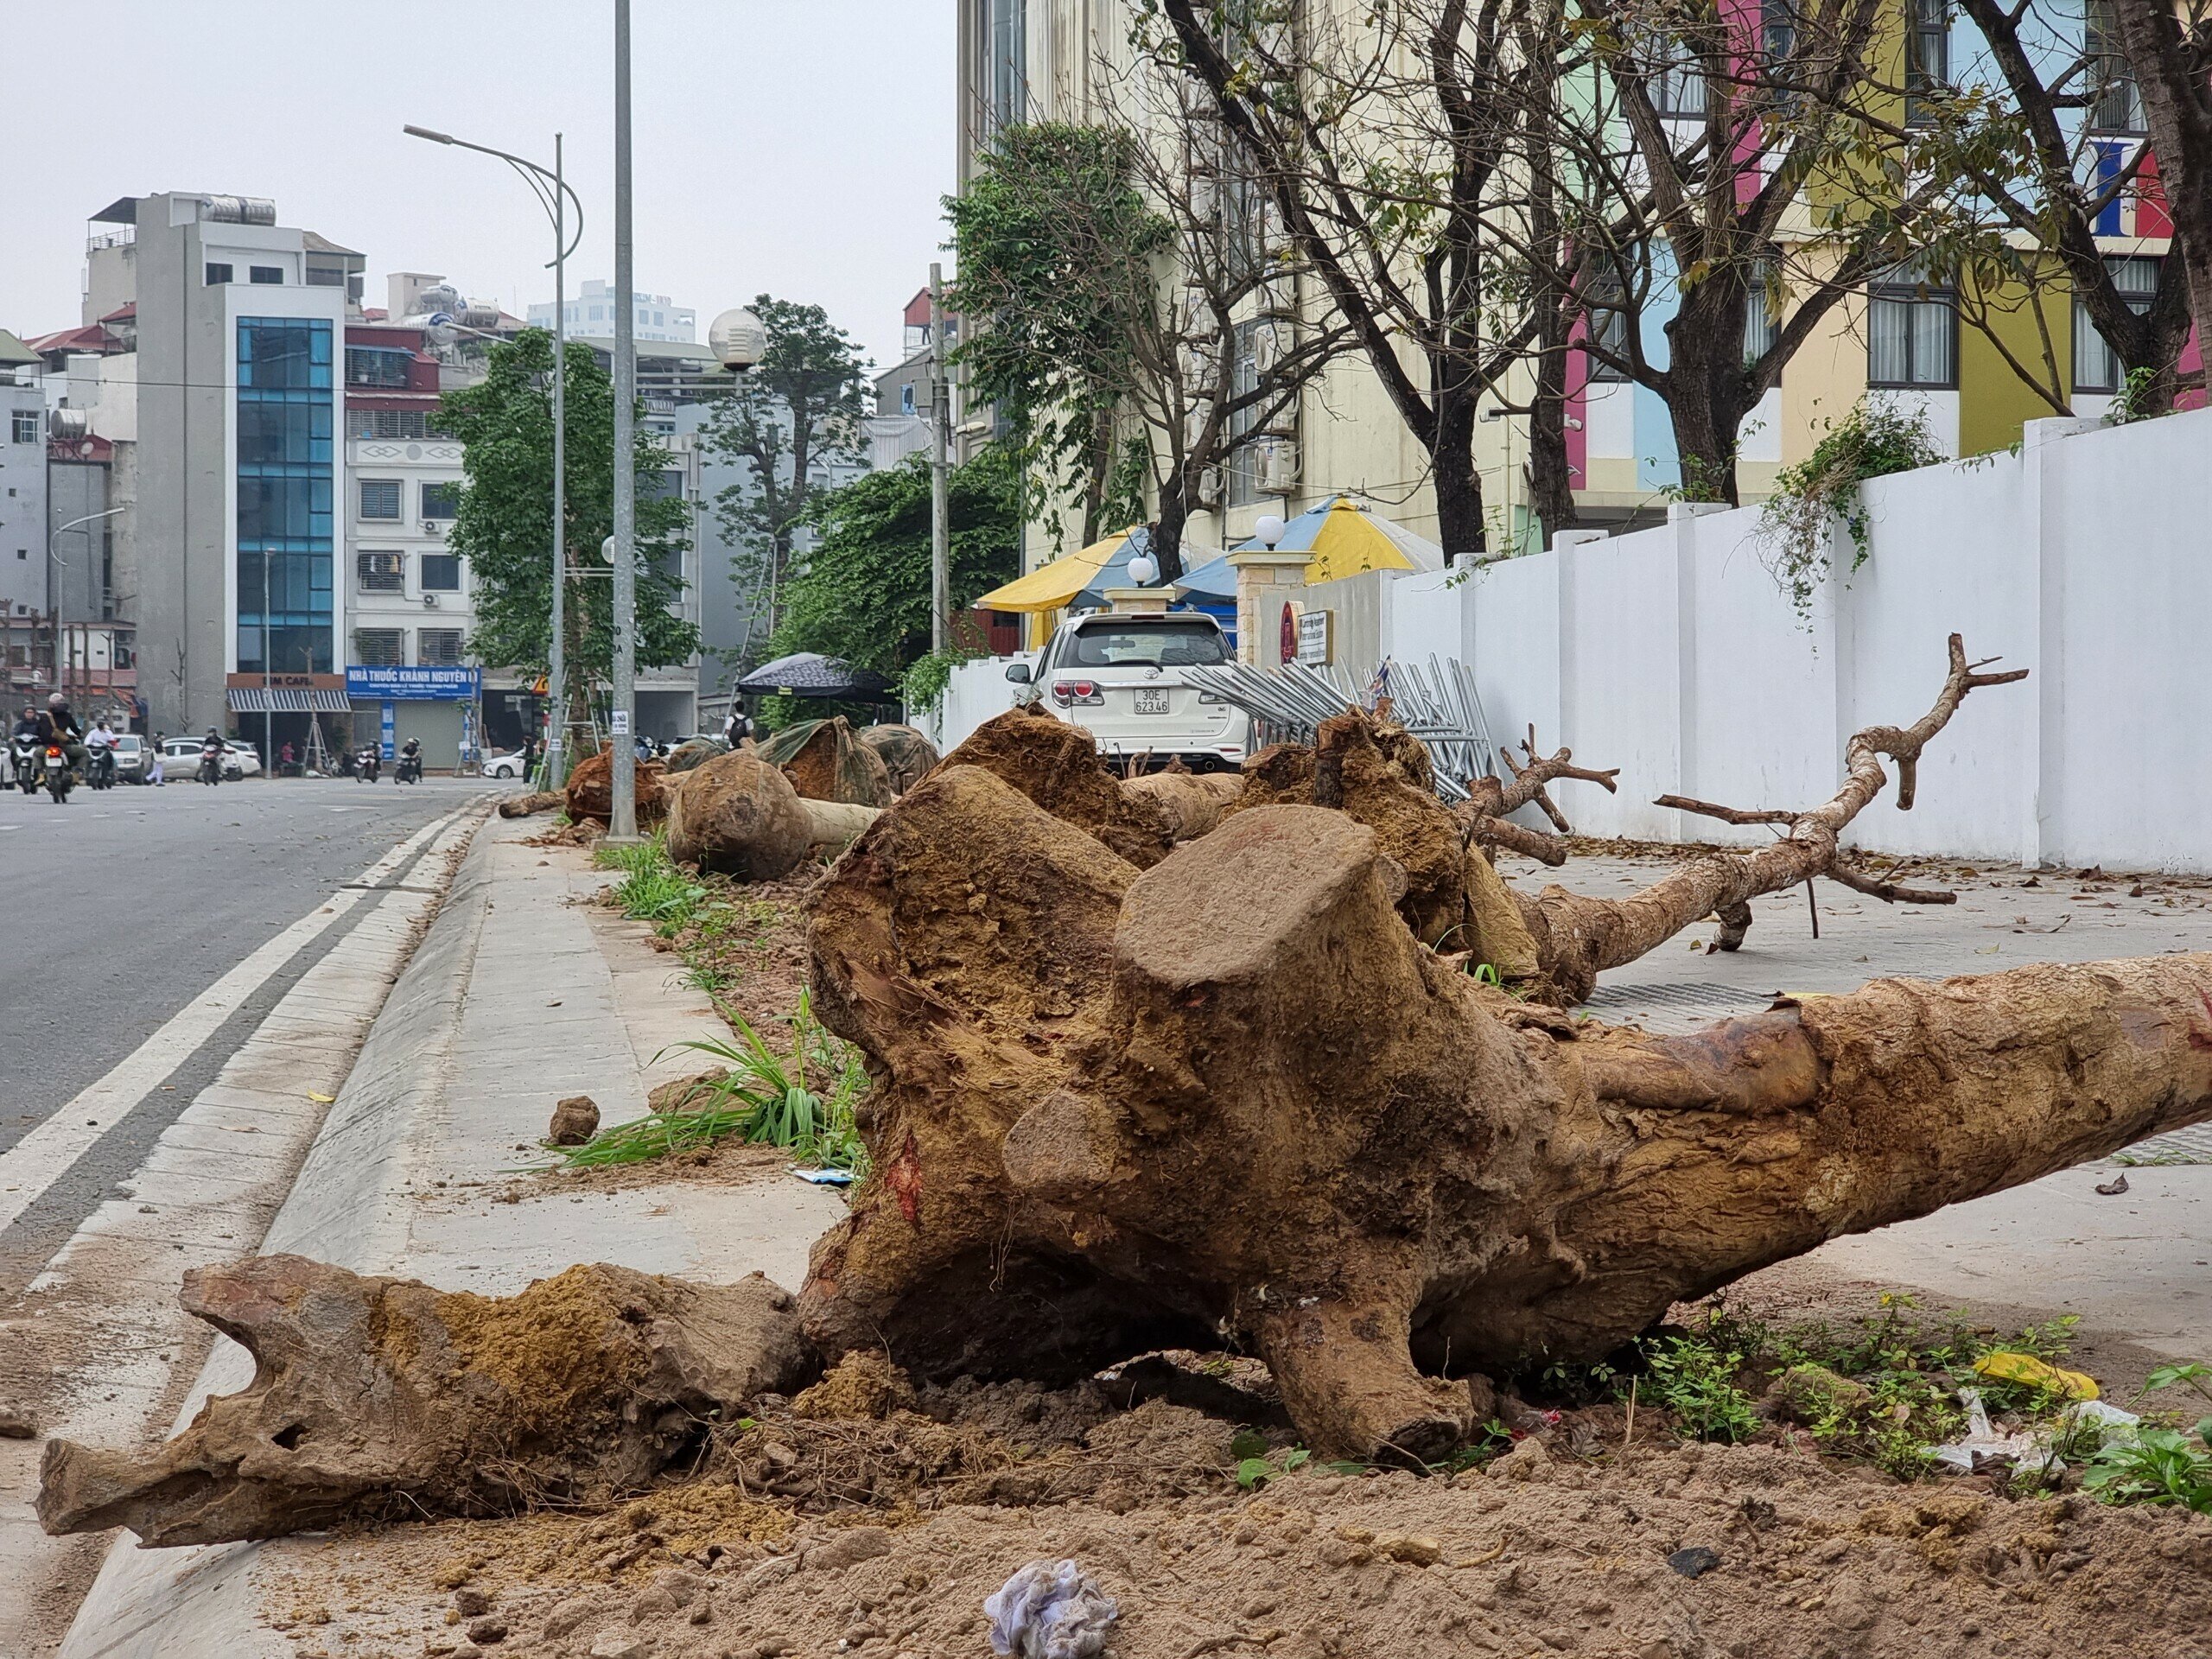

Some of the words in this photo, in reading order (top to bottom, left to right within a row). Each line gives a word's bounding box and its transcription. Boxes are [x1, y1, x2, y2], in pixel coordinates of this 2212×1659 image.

[348, 668, 368, 682] NHÀ
[369, 667, 397, 683] THUỐC
[1142, 690, 1161, 701] 30E
[1135, 701, 1168, 712] 623.46
